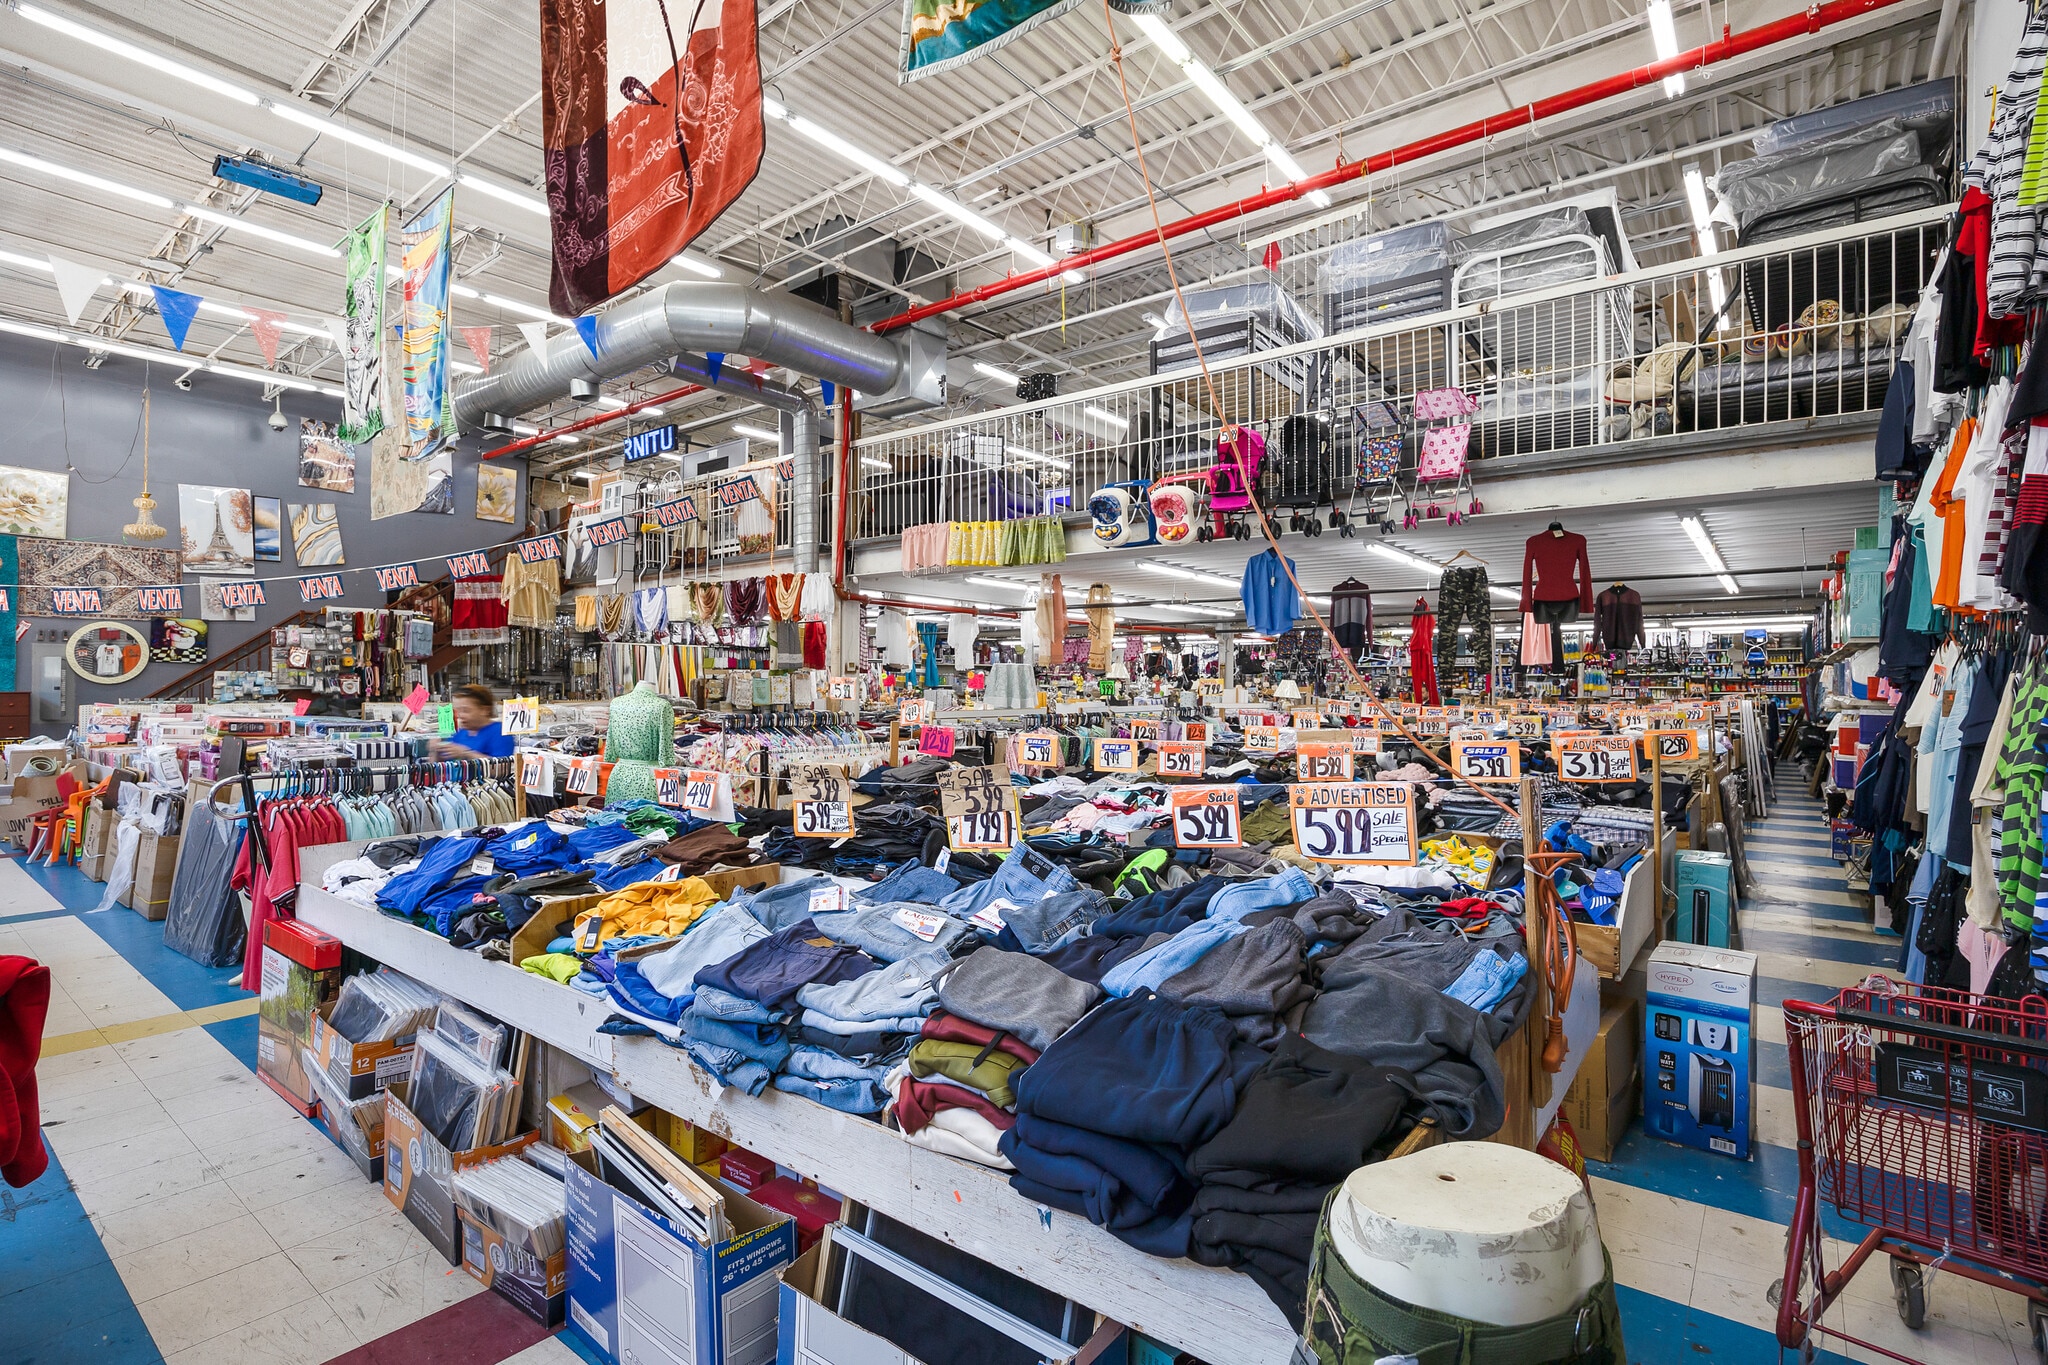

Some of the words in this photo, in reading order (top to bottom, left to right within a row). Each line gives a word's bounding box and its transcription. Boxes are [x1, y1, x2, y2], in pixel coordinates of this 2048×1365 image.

[624, 425, 673, 461] RNITU
[777, 460, 794, 481] VE
[719, 479, 758, 506] VENTA
[656, 501, 697, 527] VENTA
[587, 520, 628, 547] VENTA
[518, 538, 561, 562] VENTA
[376, 565, 419, 589] VENTA
[447, 553, 490, 577] VENTA
[138, 589, 182, 610] VENTA
[221, 583, 266, 607] VENTA
[300, 576, 344, 600] VENTA
[54, 590, 101, 611] VENTA
[1166, 753, 1191, 771] 5.99
[1465, 747, 1504, 755] SALE!
[1467, 756, 1506, 777] 5.99
[1563, 751, 1611, 777] 3.99
[704, 774, 718, 782] Sale
[806, 778, 840, 802] 3.99
[659, 778, 679, 804] 4.99
[687, 782, 712, 808] 4.99
[965, 785, 1005, 814] 5.99
[1207, 792, 1234, 803] Sale
[1310, 786, 1407, 806] ADVERTISED
[801, 801, 831, 832] 5.99
[963, 812, 1003, 842] 7.99
[1179, 804, 1233, 842] 5.99
[1373, 811, 1404, 826] SALE
[1305, 807, 1373, 856] 5.99
[1372, 834, 1409, 846] SPECIAL
[1660, 973, 1689, 984] HYPER
[356, 1057, 370, 1069] 12
[1660, 1058, 1674, 1066] WATT
[577, 1169, 592, 1188] High
[572, 1190, 581, 1204] Tools
[581, 1199, 598, 1218] Required
[579, 1188, 590, 1203] Install
[574, 1218, 598, 1243] Construction
[586, 1220, 597, 1234] Metal
[668, 1221, 695, 1243] WIDE
[568, 1238, 588, 1262] Mosquitoes
[718, 1234, 754, 1258] WINDOW
[727, 1257, 745, 1272] FITS
[746, 1237, 782, 1262] WINDOWS
[576, 1255, 588, 1272] Flying
[587, 1265, 602, 1283] Insects
[722, 1270, 738, 1284] 26"
[739, 1264, 751, 1274] TO
[752, 1254, 767, 1268] 45"
[768, 1243, 787, 1260] WIDE
[551, 1272, 566, 1288] 12
